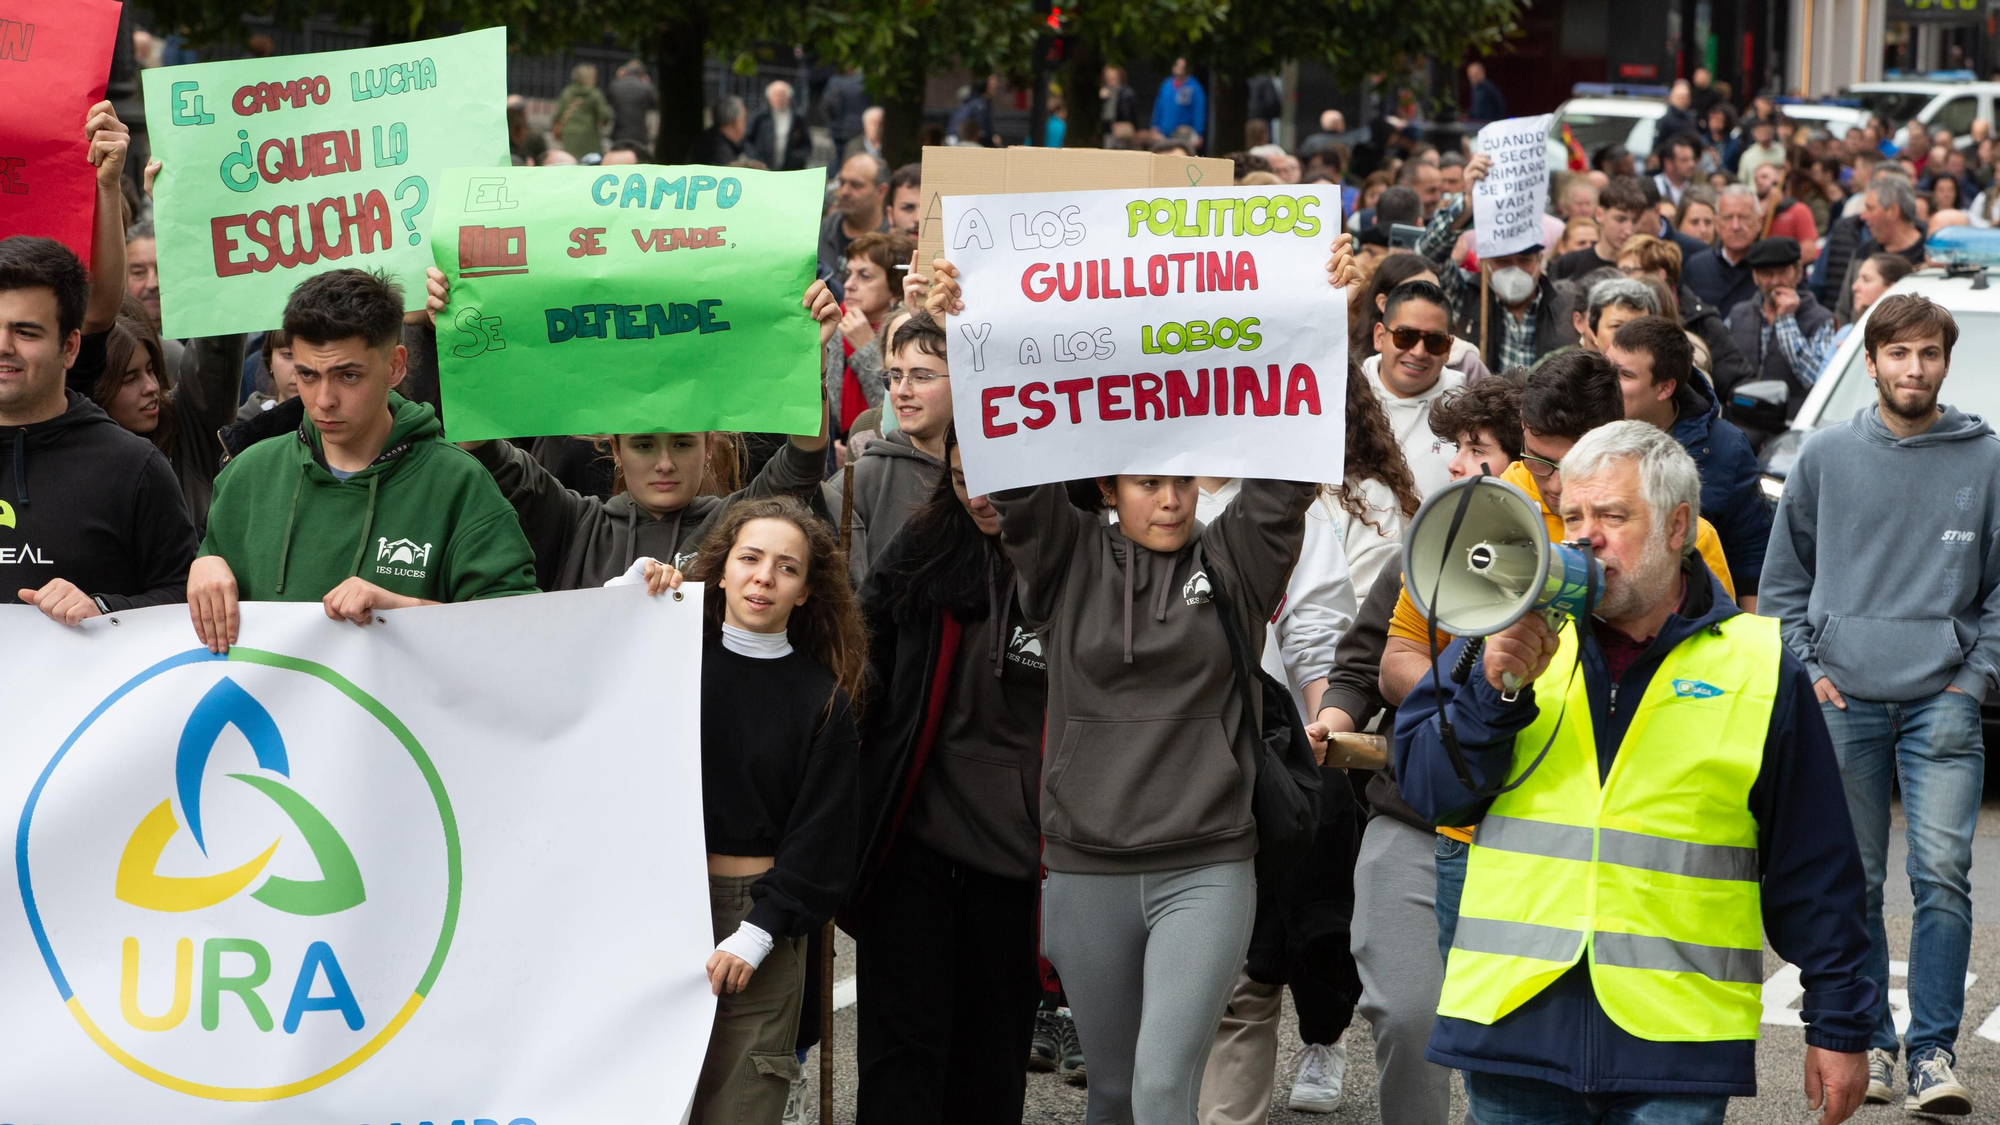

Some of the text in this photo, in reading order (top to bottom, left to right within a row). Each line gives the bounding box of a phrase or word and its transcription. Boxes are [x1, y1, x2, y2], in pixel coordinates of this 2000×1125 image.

[172, 57, 437, 126] EL CAMPO LUCHA
[220, 122, 409, 192] ¿QUIEN LO
[1483, 131, 1545, 151] CUANDO
[1480, 173, 1545, 196] SE PIERDA
[1488, 160, 1545, 180] RIMARIO
[464, 173, 742, 212] EL CAMPO
[1495, 190, 1535, 210] VAIS A
[211, 175, 429, 277] ESCUCHA?
[953, 195, 1321, 251] A LOS POLITICOS
[1493, 219, 1534, 240] MIERDA
[1495, 204, 1534, 225] COMER
[459, 225, 528, 269] NO
[567, 228, 607, 258] SE
[1021, 250, 1259, 302] GUILLOTINA
[453, 299, 731, 358] SE DEFIENDE
[961, 317, 1263, 372] Y A LOS LOBOS
[981, 363, 1322, 439] ESTERNINA
[1941, 530, 1976, 541] STWD
[376, 565, 426, 579] IES LUCES
[1186, 596, 1200, 606] IES
[1005, 652, 1021, 663] IES
[119, 936, 365, 1035] URA
